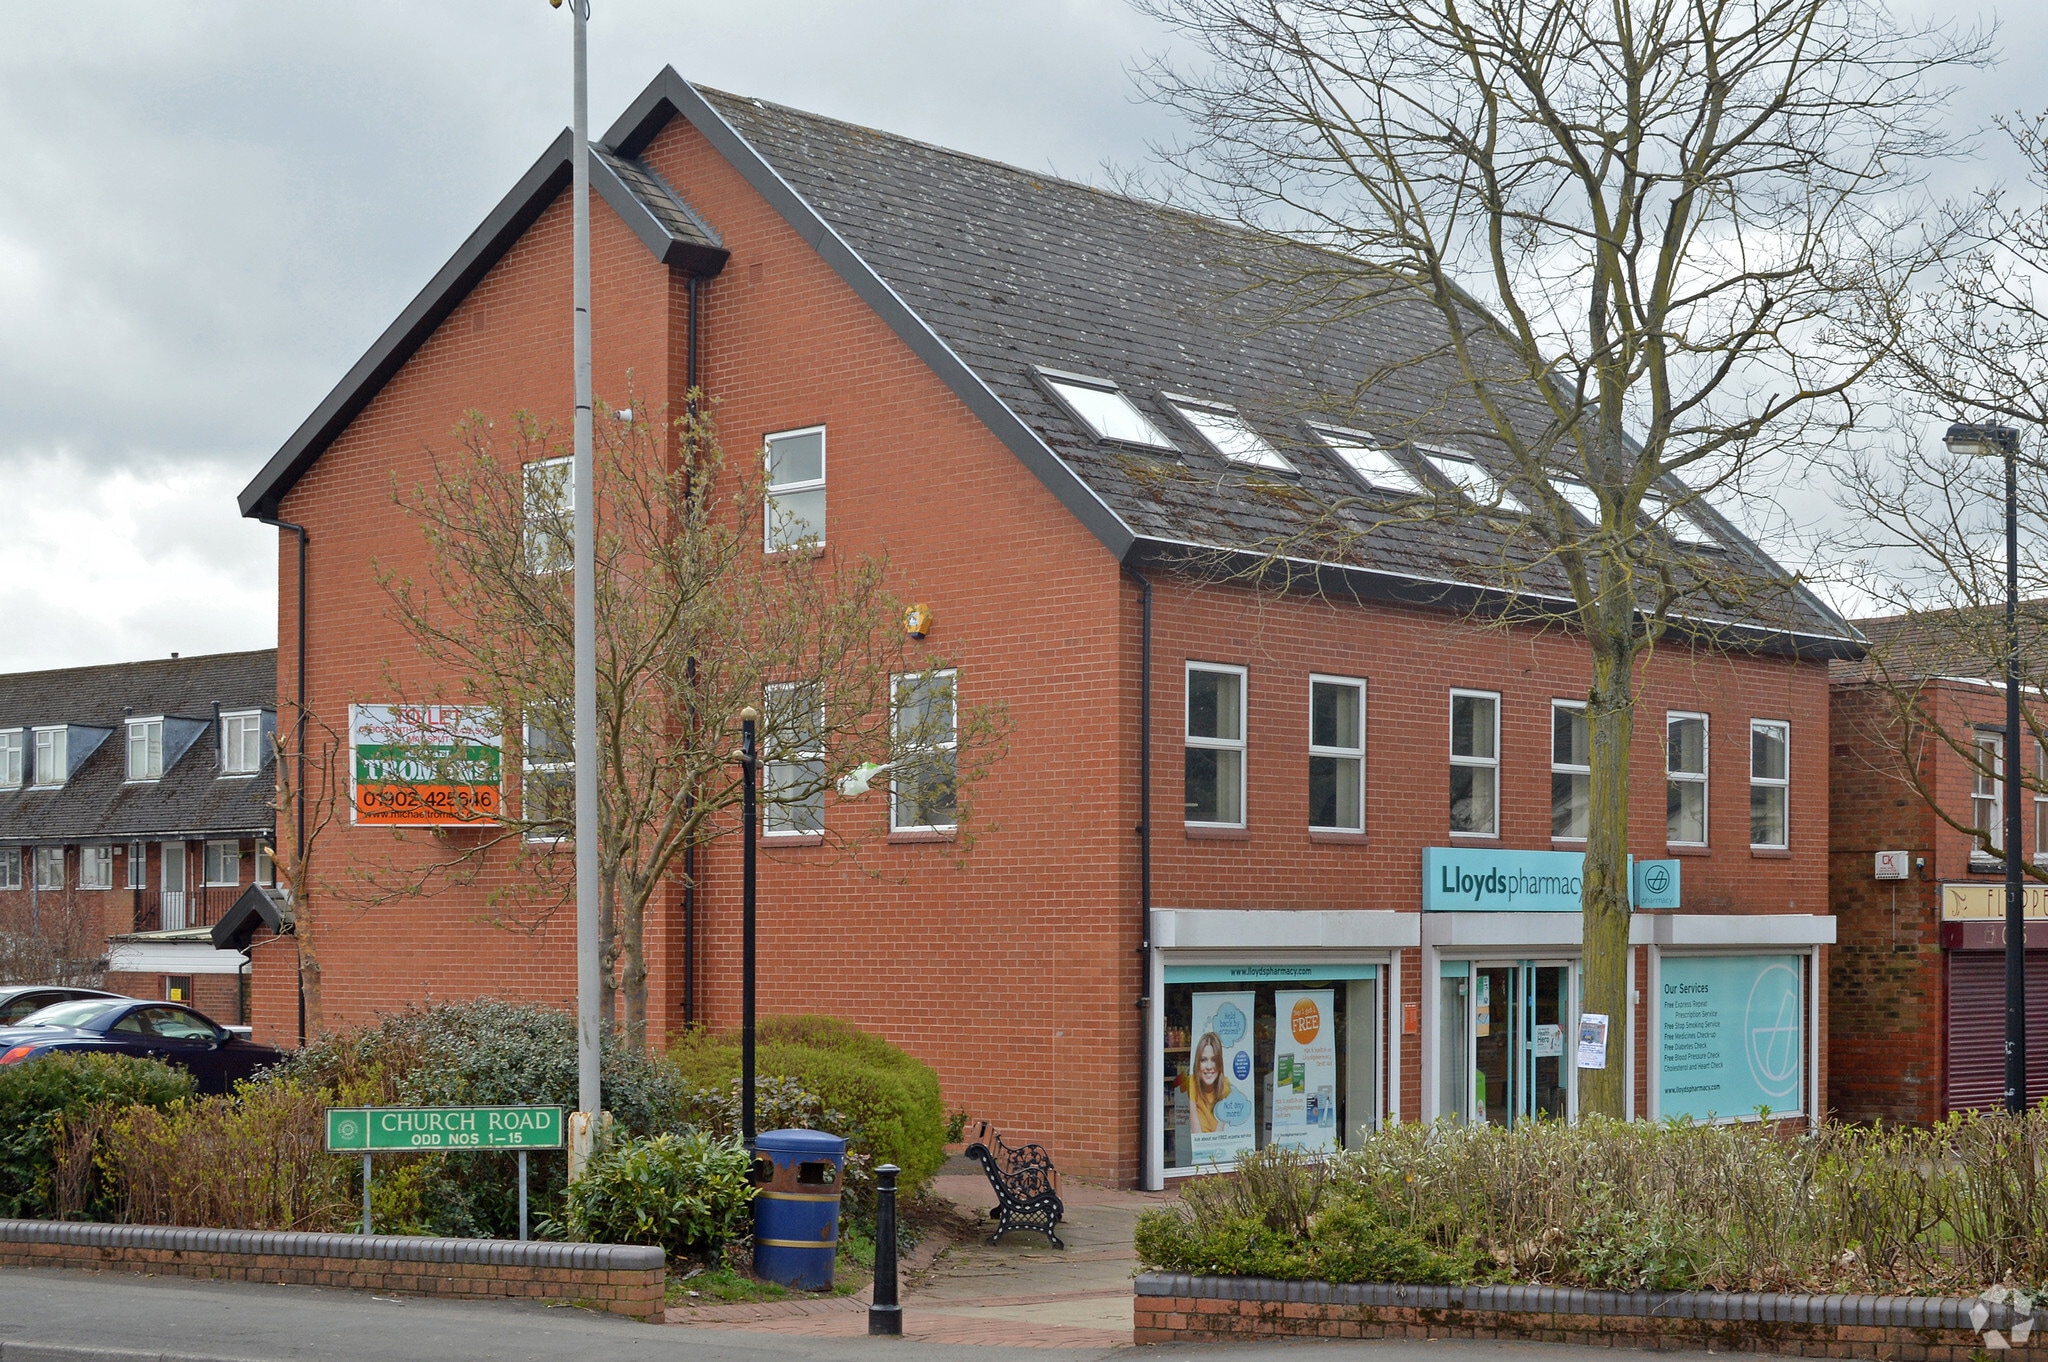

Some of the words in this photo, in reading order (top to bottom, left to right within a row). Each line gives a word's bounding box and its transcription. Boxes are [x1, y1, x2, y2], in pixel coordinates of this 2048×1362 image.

[397, 709, 421, 725] TO
[428, 709, 461, 725] LET
[363, 759, 490, 781] TROMNS
[364, 791, 418, 806] 01902
[425, 791, 492, 807] 425646
[1230, 967, 1312, 977] www.lloydspharmacy.com
[1664, 983, 1677, 994] Our
[1679, 982, 1709, 994] Services
[1692, 1000, 1708, 1008] Repeat
[1675, 1011, 1701, 1019] Prescription
[1701, 1010, 1718, 1018] Service
[1292, 1014, 1319, 1033] FREE
[1675, 1022, 1685, 1030] Stop
[1686, 1021, 1704, 1029] Smoking
[1704, 1020, 1720, 1028] Service
[1675, 1032, 1696, 1040] Medicines
[1675, 1053, 1687, 1061] Blood
[1687, 1052, 1706, 1060] Pressure
[1707, 1051, 1720, 1059] Check
[1664, 1064, 1688, 1072] Cholesterol
[1710, 1061, 1723, 1069] Check
[1664, 1084, 1721, 1094] www.lloydspharmacy.com
[1223, 1101, 1233, 1110] Not
[1234, 1101, 1245, 1112] any
[381, 1112, 476, 1132] CHURCH
[489, 1111, 551, 1130] ROAD
[411, 1133, 440, 1146] ODD
[449, 1132, 479, 1145] NOS
